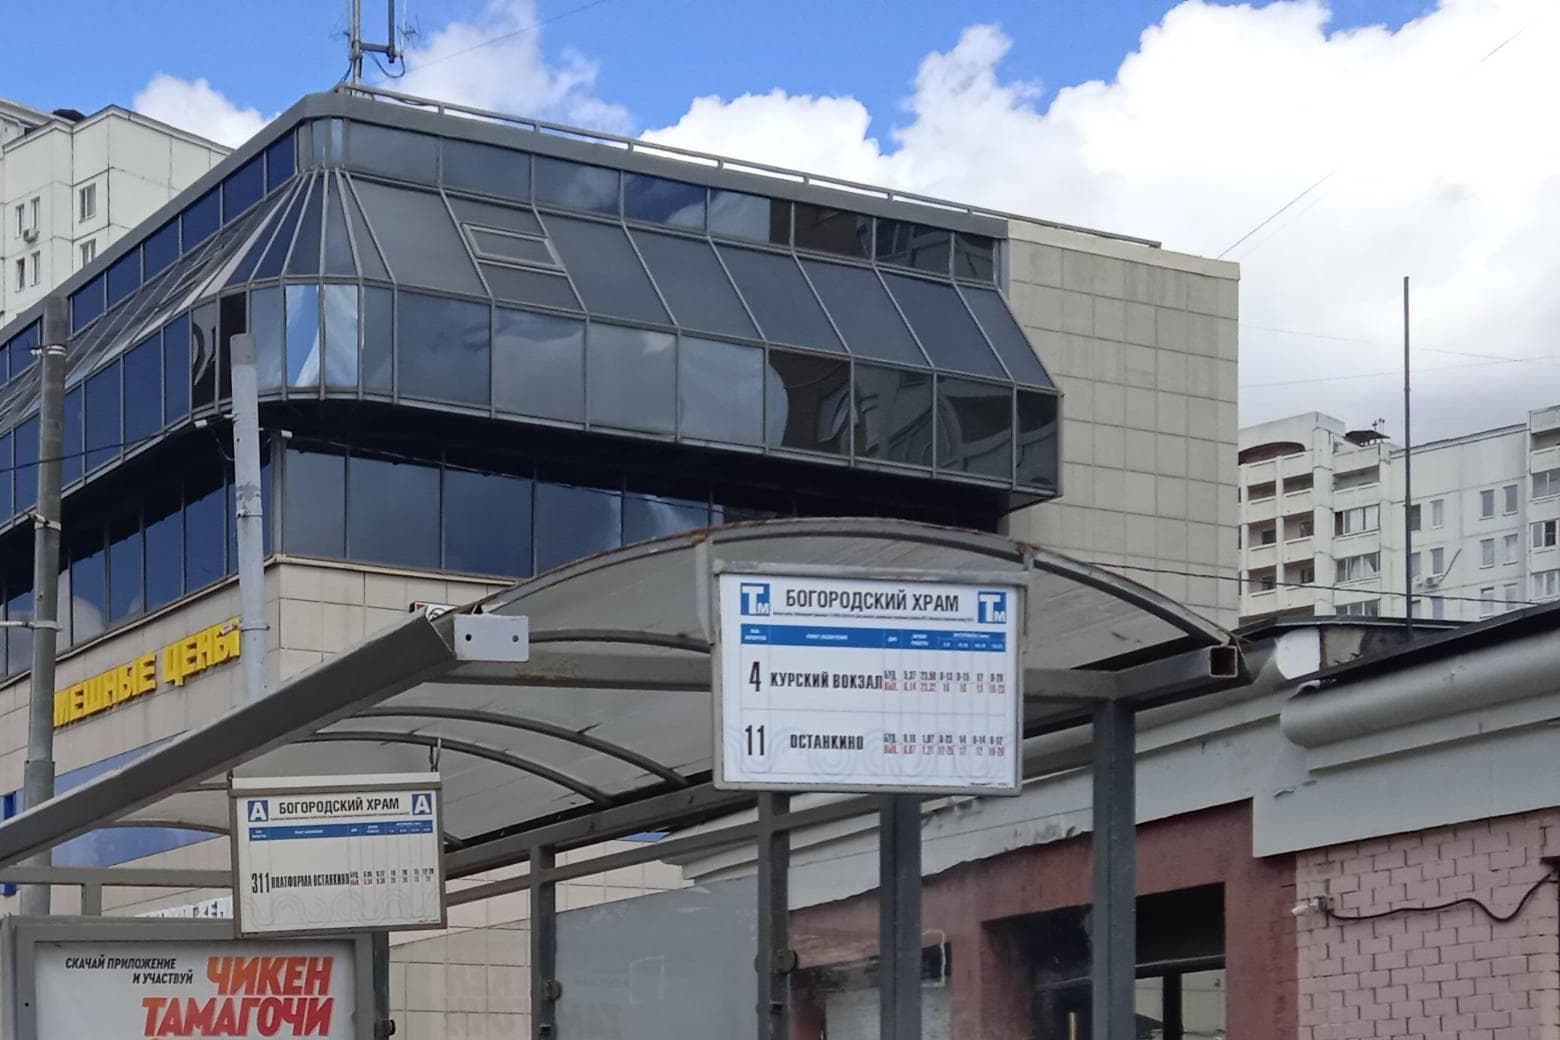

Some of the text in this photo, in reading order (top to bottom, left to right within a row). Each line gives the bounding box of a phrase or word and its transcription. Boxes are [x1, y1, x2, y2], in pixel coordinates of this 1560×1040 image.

[785, 588, 959, 612] БОГОРОДСКИЙ ХРАМ
[53, 616, 240, 729] МЕШНЫЕ ЦЕНЫ
[748, 661, 762, 692] 4
[770, 670, 829, 689] КУРСКИЙ
[832, 674, 883, 690] ВОКЗАЛ
[744, 724, 766, 757] 11
[790, 734, 864, 750] ОСТАНКИНО
[279, 797, 400, 815] БОГОРОДСКИЙ ХРАМ
[251, 872, 270, 894] 311
[65, 954, 177, 969] СКАЧАЙ ПРИЛОЖЕНИЕ
[131, 968, 193, 984] И УЧАСТВУЙ
[207, 956, 334, 996] ЧИКЕН
[142, 997, 334, 1037] ТАМАГОЧИ
